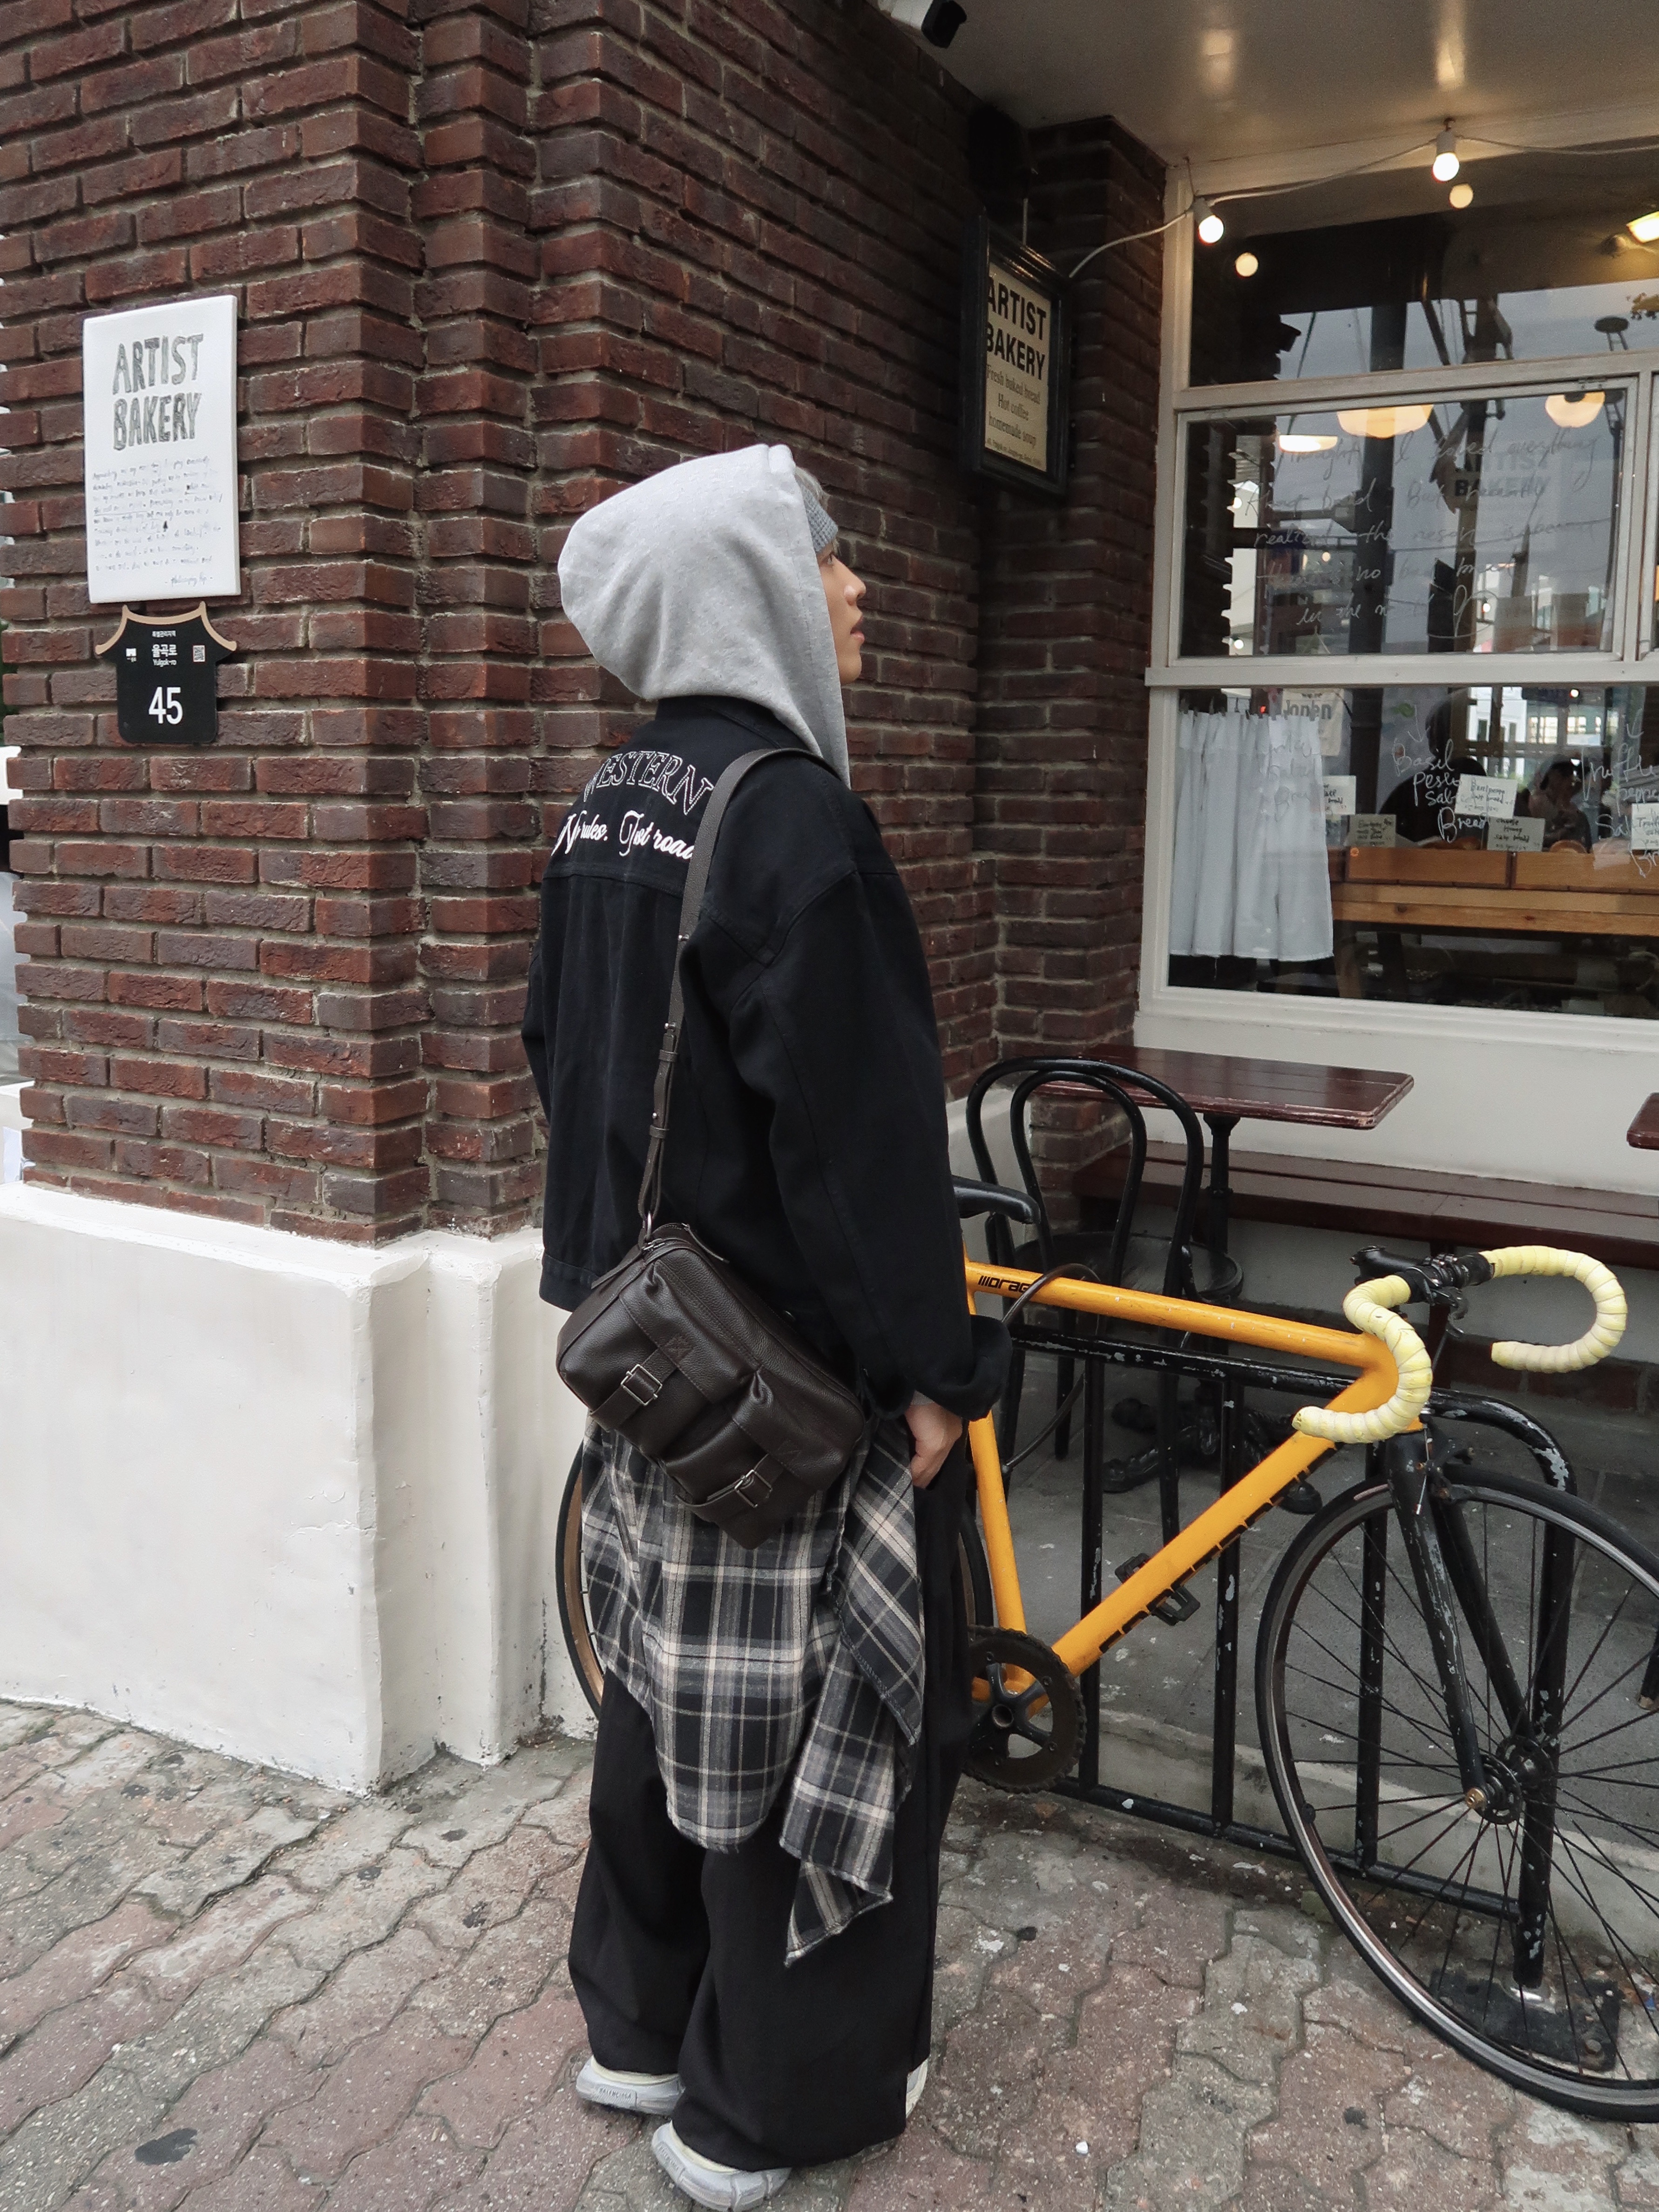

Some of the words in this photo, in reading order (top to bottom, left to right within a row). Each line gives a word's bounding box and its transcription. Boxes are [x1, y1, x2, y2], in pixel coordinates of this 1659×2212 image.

[112, 333, 203, 395] ARTIST
[114, 392, 202, 451] BAKERY
[152, 644, 178, 658] 율곡로
[149, 686, 183, 724] 45
[1393, 737, 1455, 777] Basil
